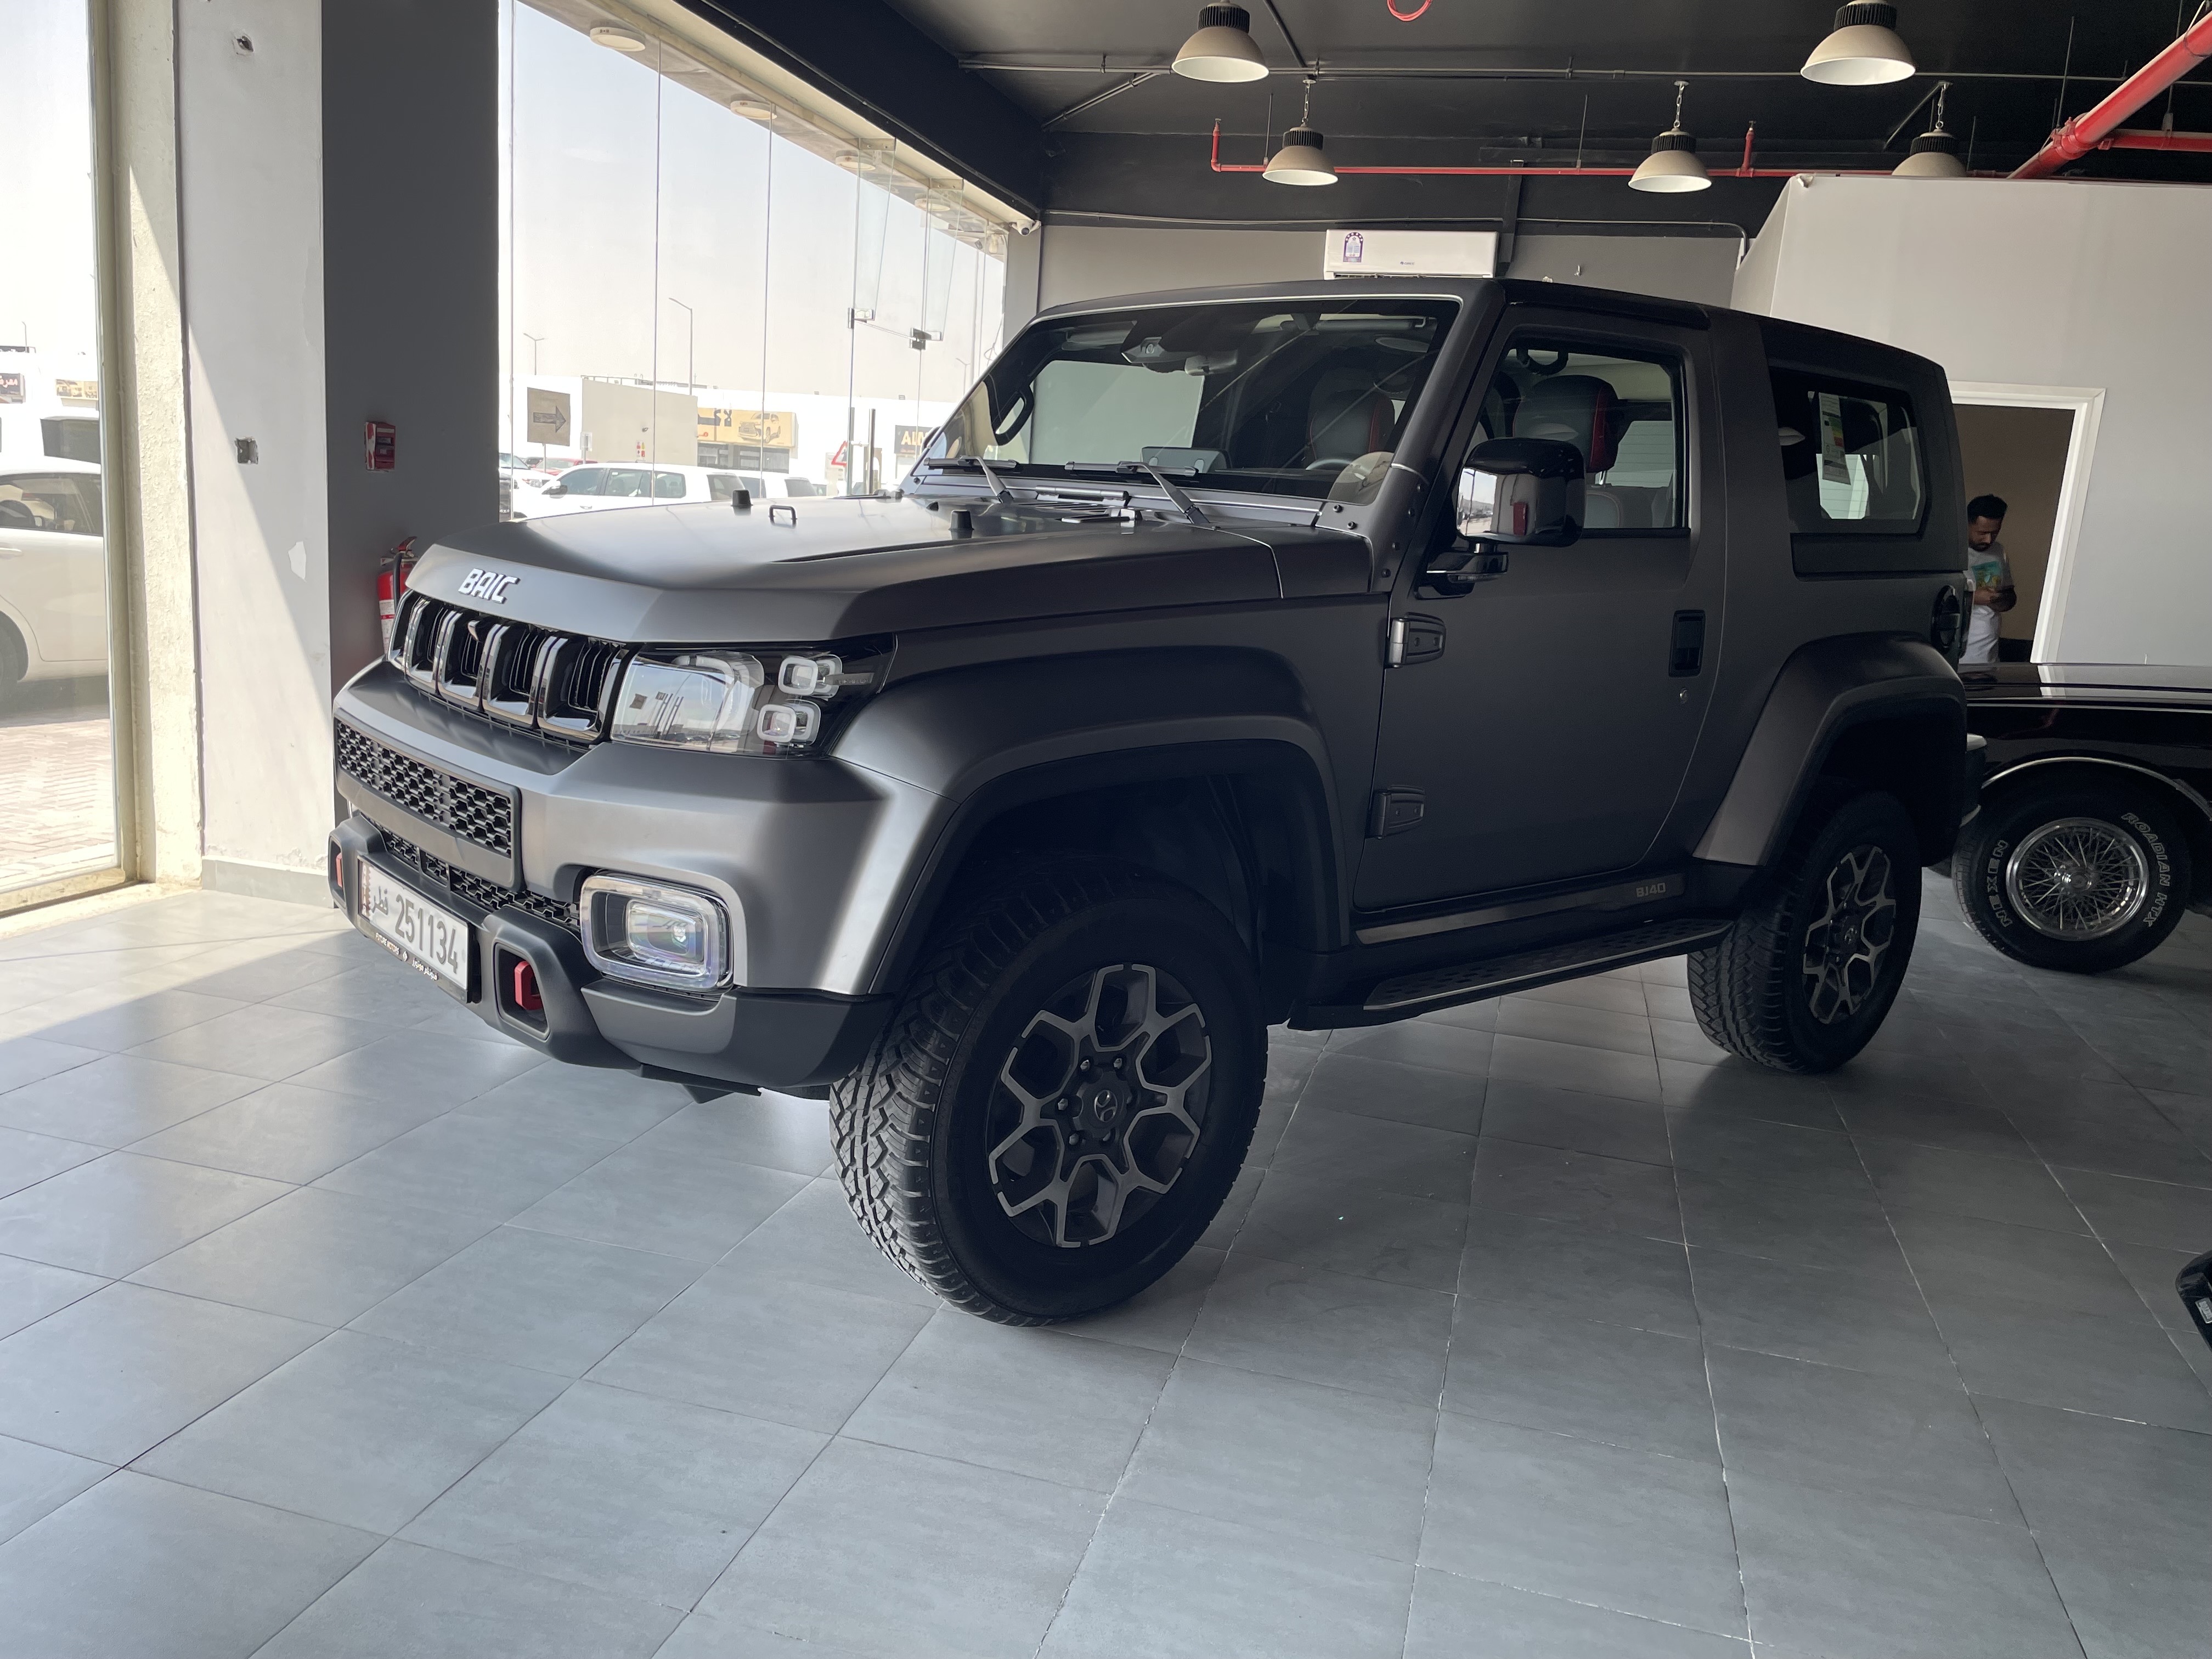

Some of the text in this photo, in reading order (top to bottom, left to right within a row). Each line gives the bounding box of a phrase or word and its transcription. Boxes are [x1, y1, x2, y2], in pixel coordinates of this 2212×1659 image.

[458, 568, 521, 604] BAIC
[1635, 882, 1666, 898] BJ40
[1987, 839, 2013, 927] NEXEN
[2120, 812, 2171, 927] ROADIAN HTX
[371, 885, 388, 916] قطر
[395, 894, 458, 974] 251134
